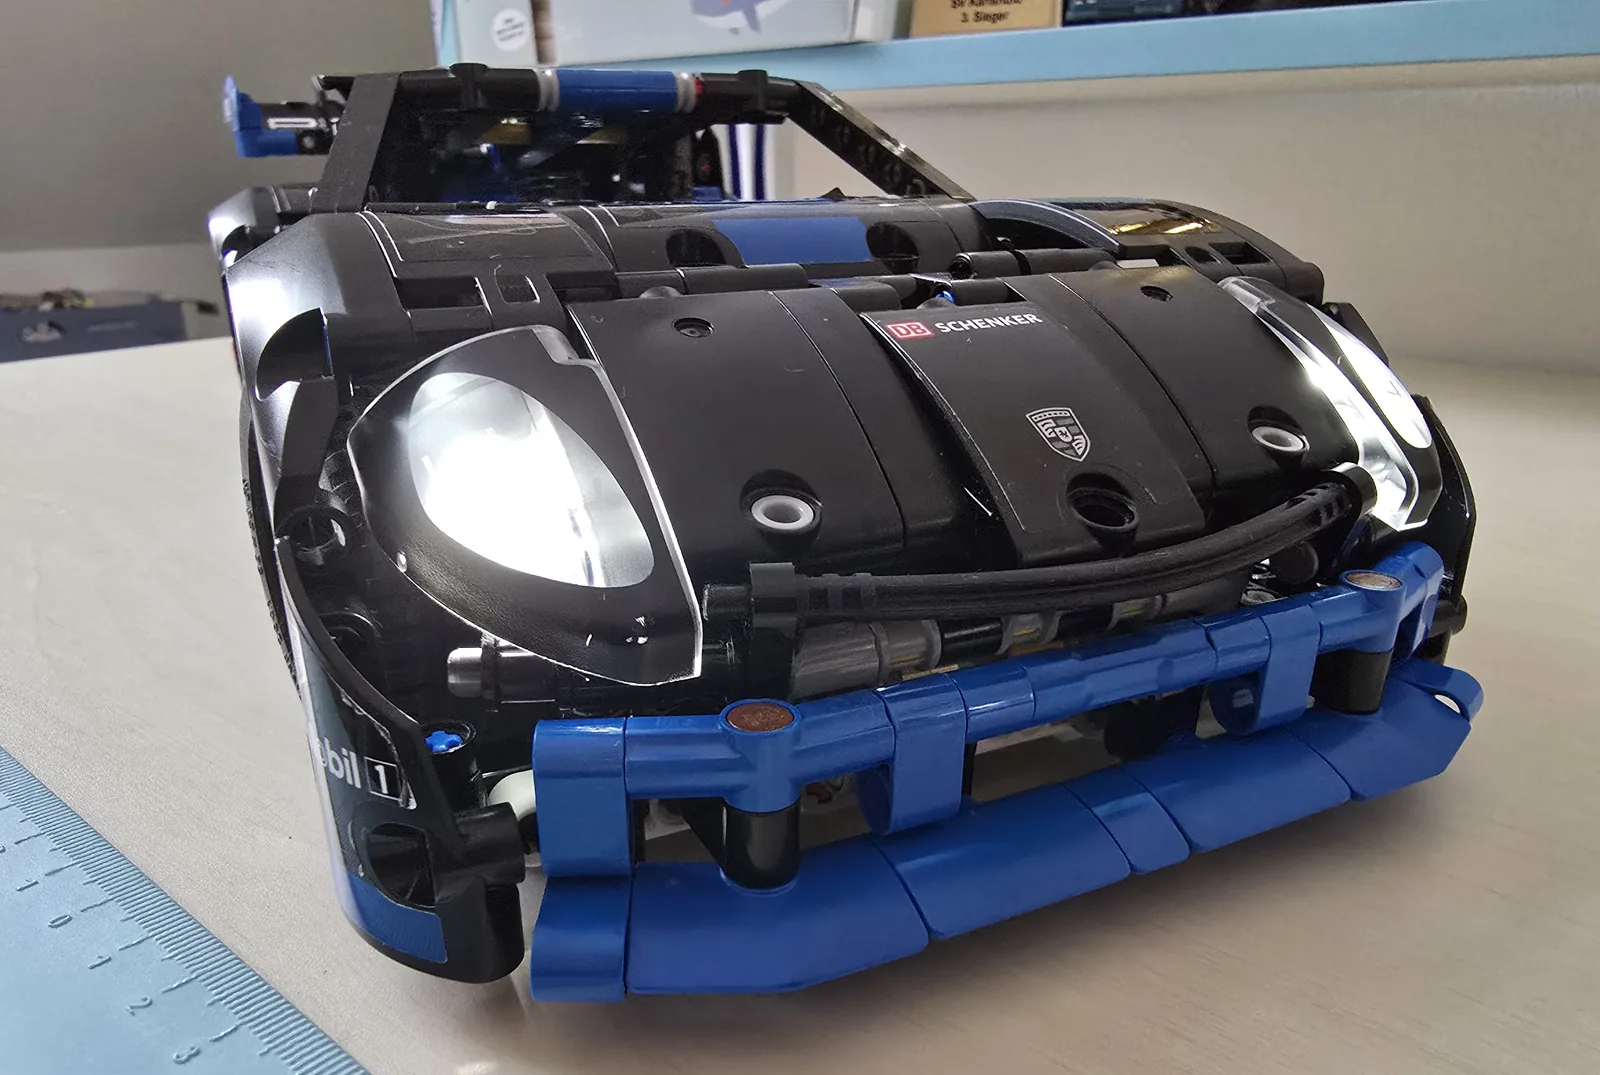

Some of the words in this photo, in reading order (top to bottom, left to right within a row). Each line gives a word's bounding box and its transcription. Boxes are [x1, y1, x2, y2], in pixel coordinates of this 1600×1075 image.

[890, 323, 929, 337] DB
[935, 313, 1043, 333] SCHENKER
[374, 765, 389, 794] 1
[125, 997, 153, 1016] 2
